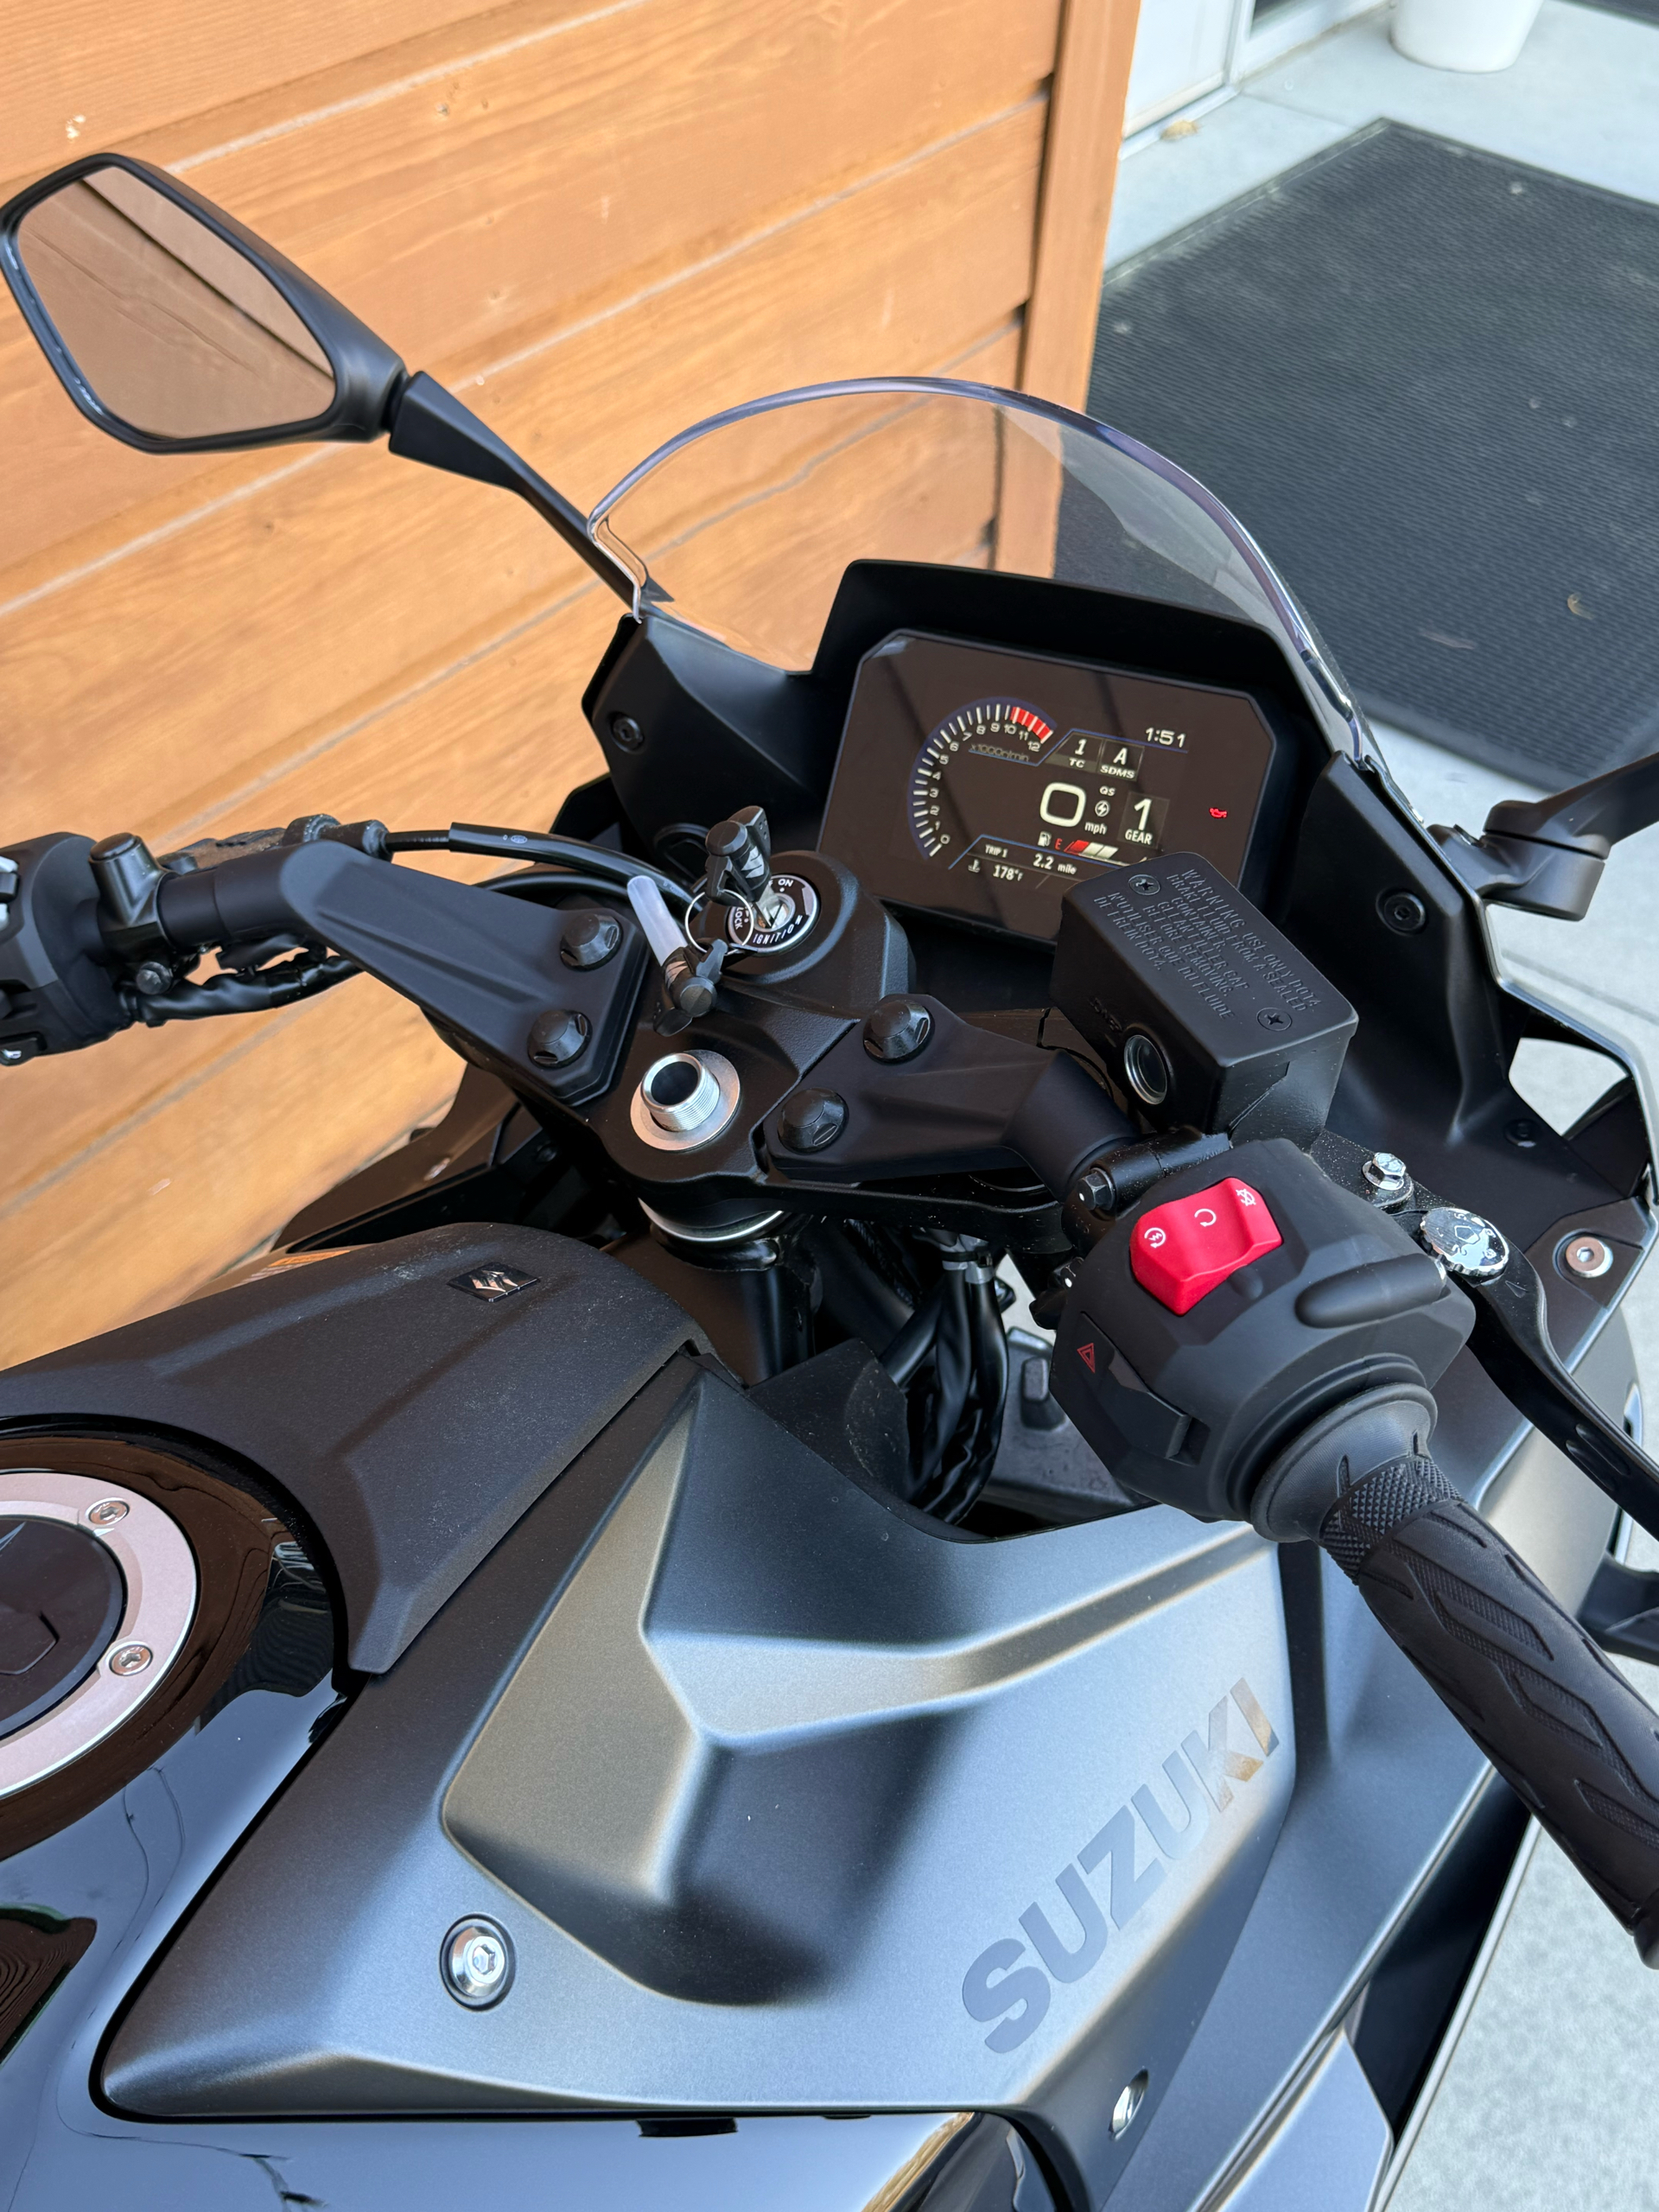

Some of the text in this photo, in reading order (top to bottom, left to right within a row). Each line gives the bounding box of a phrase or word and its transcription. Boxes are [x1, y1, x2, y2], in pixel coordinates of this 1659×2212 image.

[976, 725, 986, 734] 8
[990, 722, 1000, 733] 9
[1004, 724, 1017, 734] 10
[962, 732, 973, 741] 7
[1019, 731, 1029, 741] 11
[1145, 727, 1186, 748] 1:51
[950, 742, 959, 752] 6
[1028, 741, 1041, 752] 12
[1074, 739, 1087, 756] 1
[938, 754, 949, 766] 5
[1069, 758, 1086, 768] TC
[1113, 747, 1128, 766] A
[931, 771, 942, 781] 4
[1100, 765, 1136, 779] SDMS
[929, 787, 939, 798] 3
[1099, 785, 1116, 797] QS
[929, 805, 940, 817] 2
[1039, 782, 1087, 828] 0
[1134, 798, 1153, 831] 1
[1084, 822, 1107, 835] mph
[940, 834, 950, 844] 0
[1054, 837, 1063, 850] E
[1125, 829, 1154, 845] GEAR
[985, 844, 1001, 857] TRIP
[1033, 853, 1077, 876] 2.2 mile
[778, 878, 793, 887] ON
[734, 907, 744, 930] LOCK
[1093, 896, 1115, 910] DE
[1107, 911, 1141, 941] FREIN
[1171, 897, 1226, 952] CONTAINER.
[1182, 868, 1246, 929] WARNING
[1243, 931, 1267, 953] USE
[1263, 954, 1294, 978] ONLY
[753, 914, 803, 944] IGNITION
[1157, 901, 1250, 989] CLEAN FILLER CAP
[1166, 874, 1202, 903] BRAKE
[1198, 905, 1232, 938] FLUID
[1226, 934, 1260, 963] FROM
[1262, 971, 1309, 1011] SEALED
[1142, 905, 1234, 997] BEFORE REMOVING.
[1158, 945, 1186, 967] QUE
[1177, 966, 1199, 981] DU
[1192, 982, 1236, 1020] FLUIDE
[962, 1677, 1280, 2054] SUZUKI
